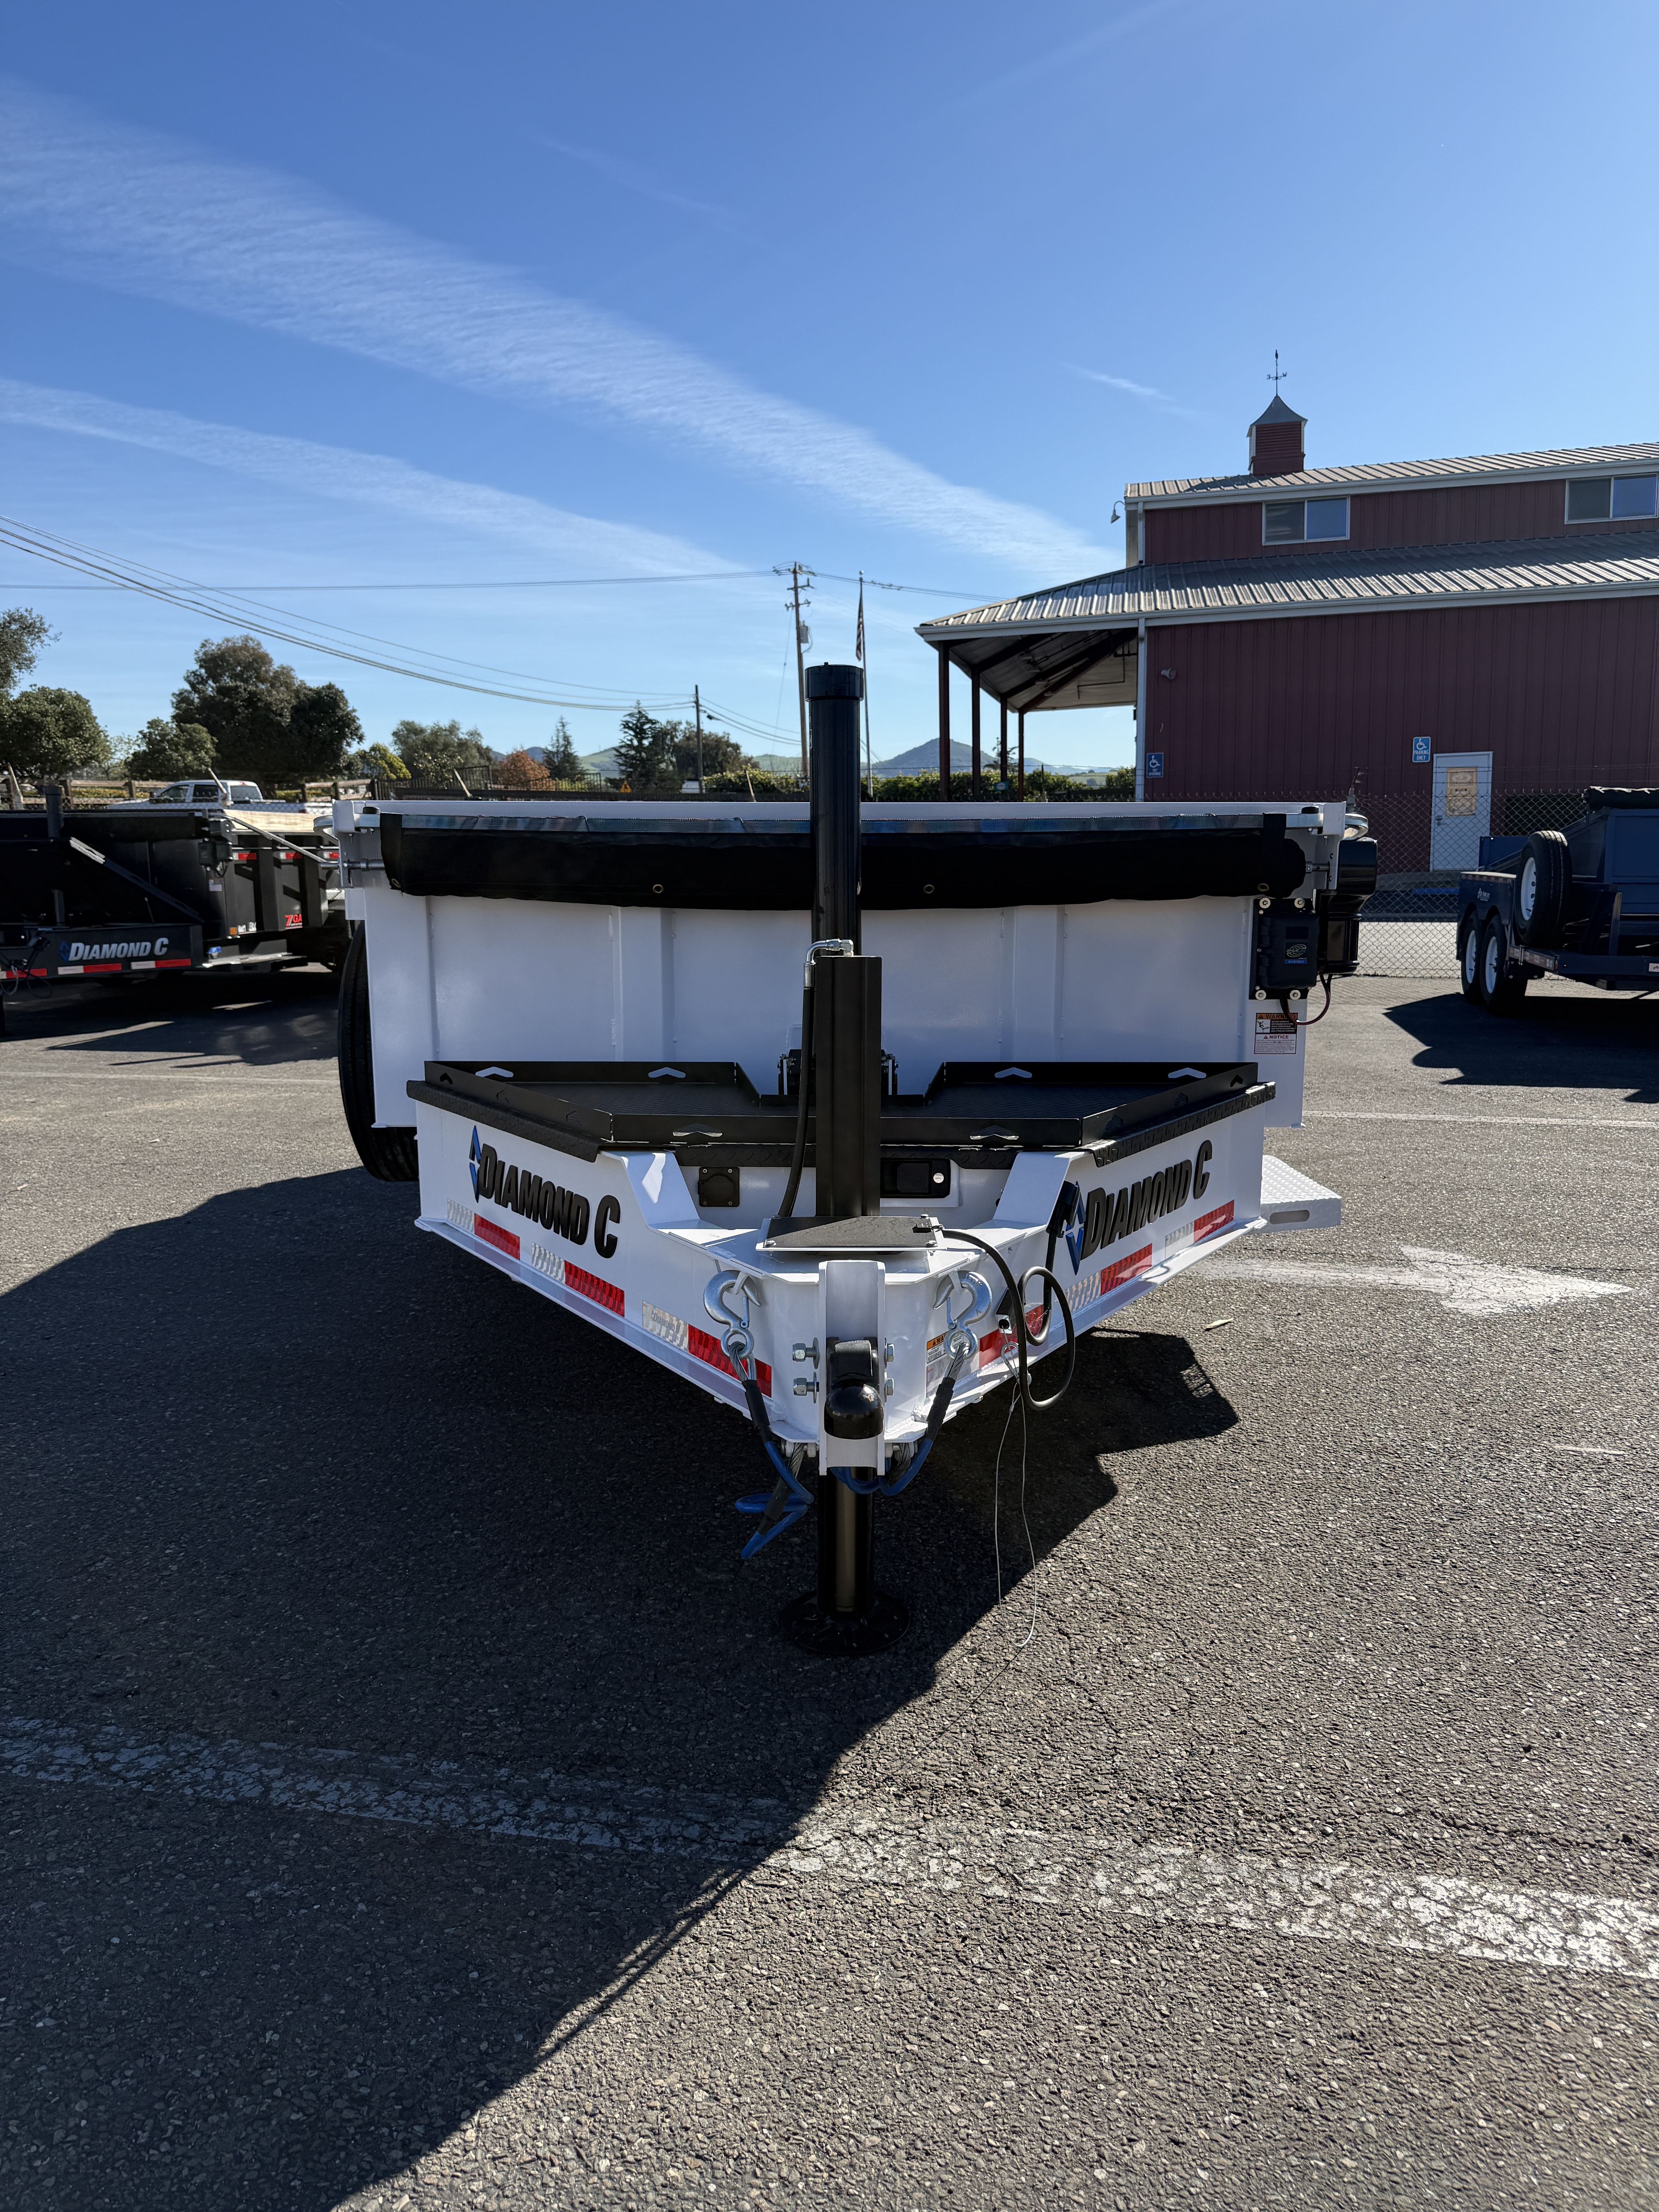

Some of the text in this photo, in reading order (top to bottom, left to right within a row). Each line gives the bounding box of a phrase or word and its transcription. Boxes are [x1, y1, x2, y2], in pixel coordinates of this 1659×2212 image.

[69, 938, 169, 961] DIAMOND C
[479, 1143, 620, 1259] DIAMOND C
[1081, 1140, 1212, 1260] DIAMOND C
